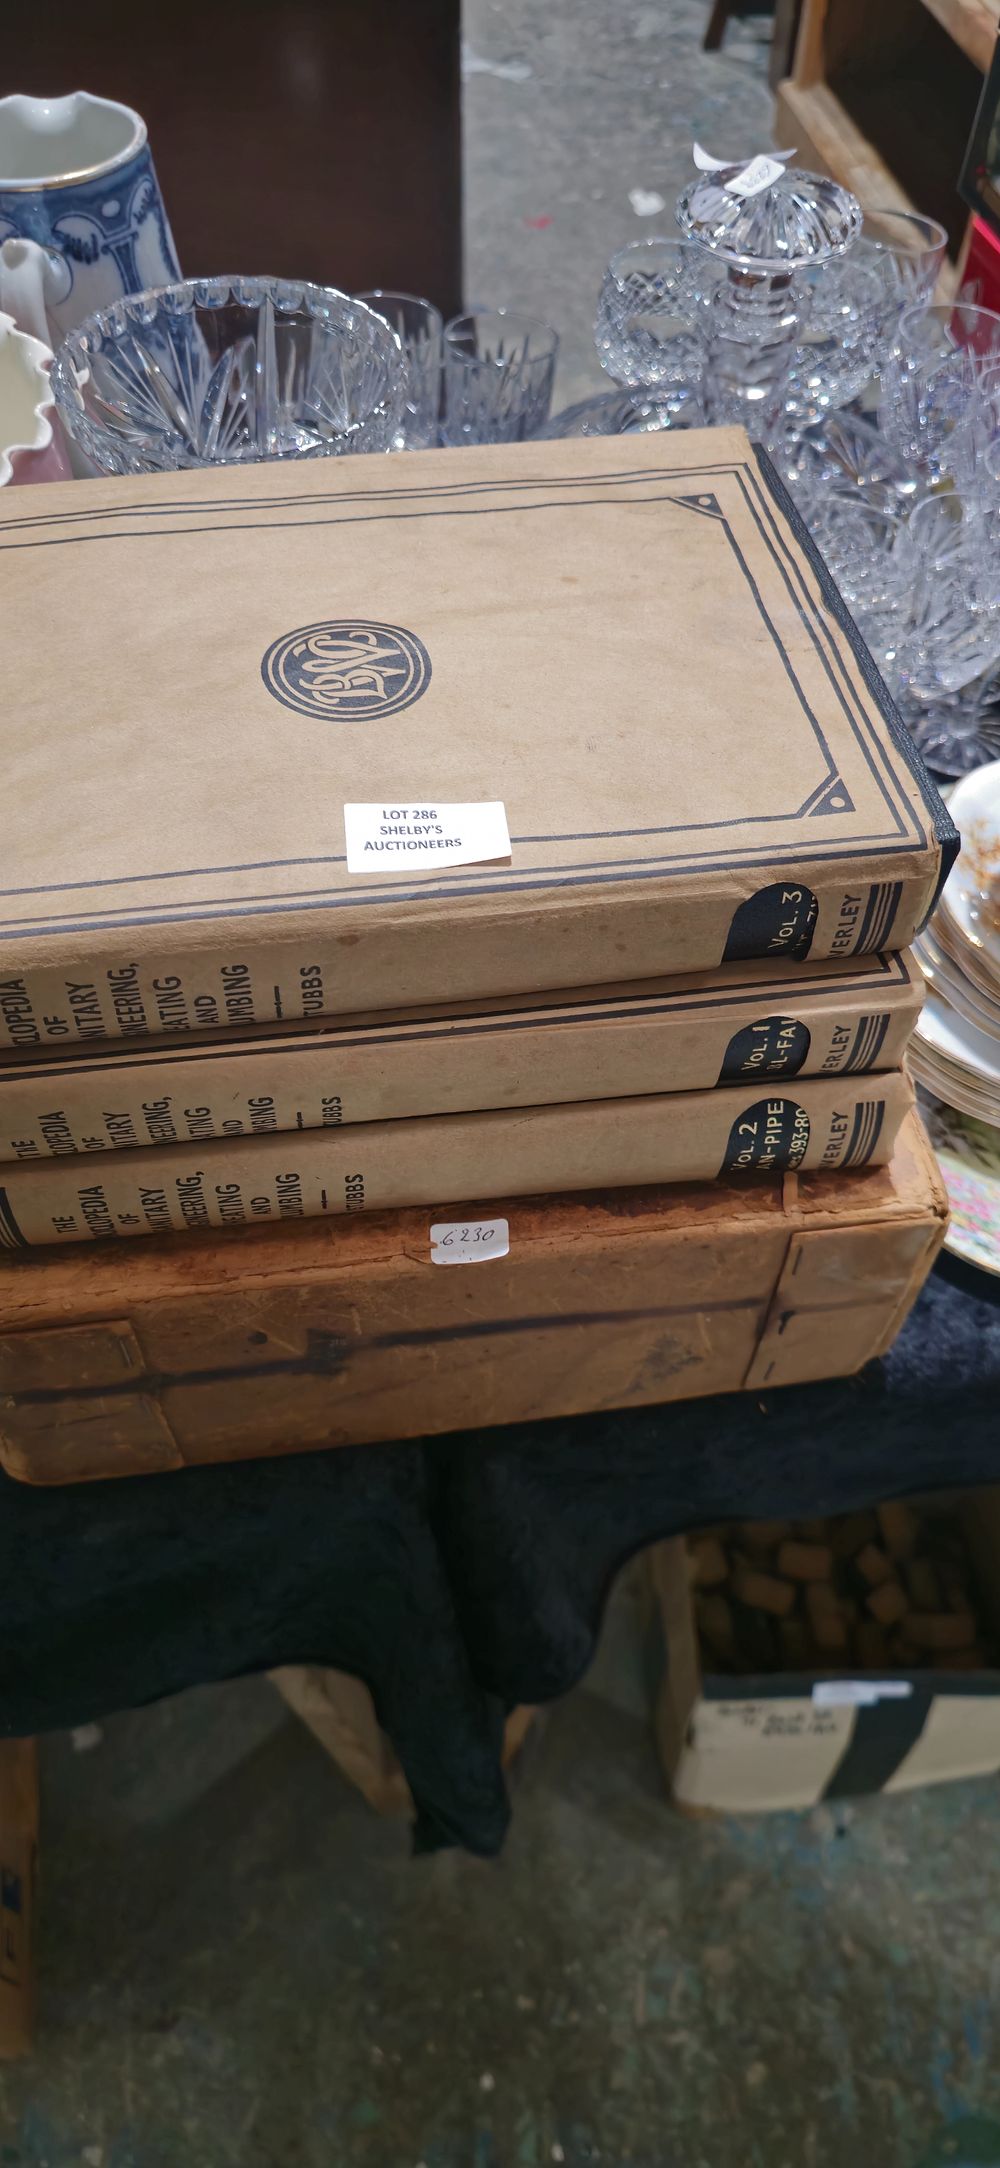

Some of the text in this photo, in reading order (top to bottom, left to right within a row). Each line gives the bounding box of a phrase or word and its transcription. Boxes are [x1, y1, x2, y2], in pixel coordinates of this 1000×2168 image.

[382, 809, 438, 820] LOT 286
[379, 824, 443, 836] SHELBY'S
[363, 837, 462, 851] AUCTIONEERS
[781, 889, 802, 905] 3
[827, 894, 861, 959] VERLEY
[194, 995, 220, 1024] AND
[43, 1015, 69, 1036] OF
[738, 1121, 758, 1135] 2
[11, 1139, 41, 1159] THE
[81, 1136, 106, 1150] OF
[250, 1196, 272, 1215] AND
[51, 1215, 79, 1234] THE
[117, 1213, 141, 1225] OF
[442, 1226, 496, 1246] 6230
